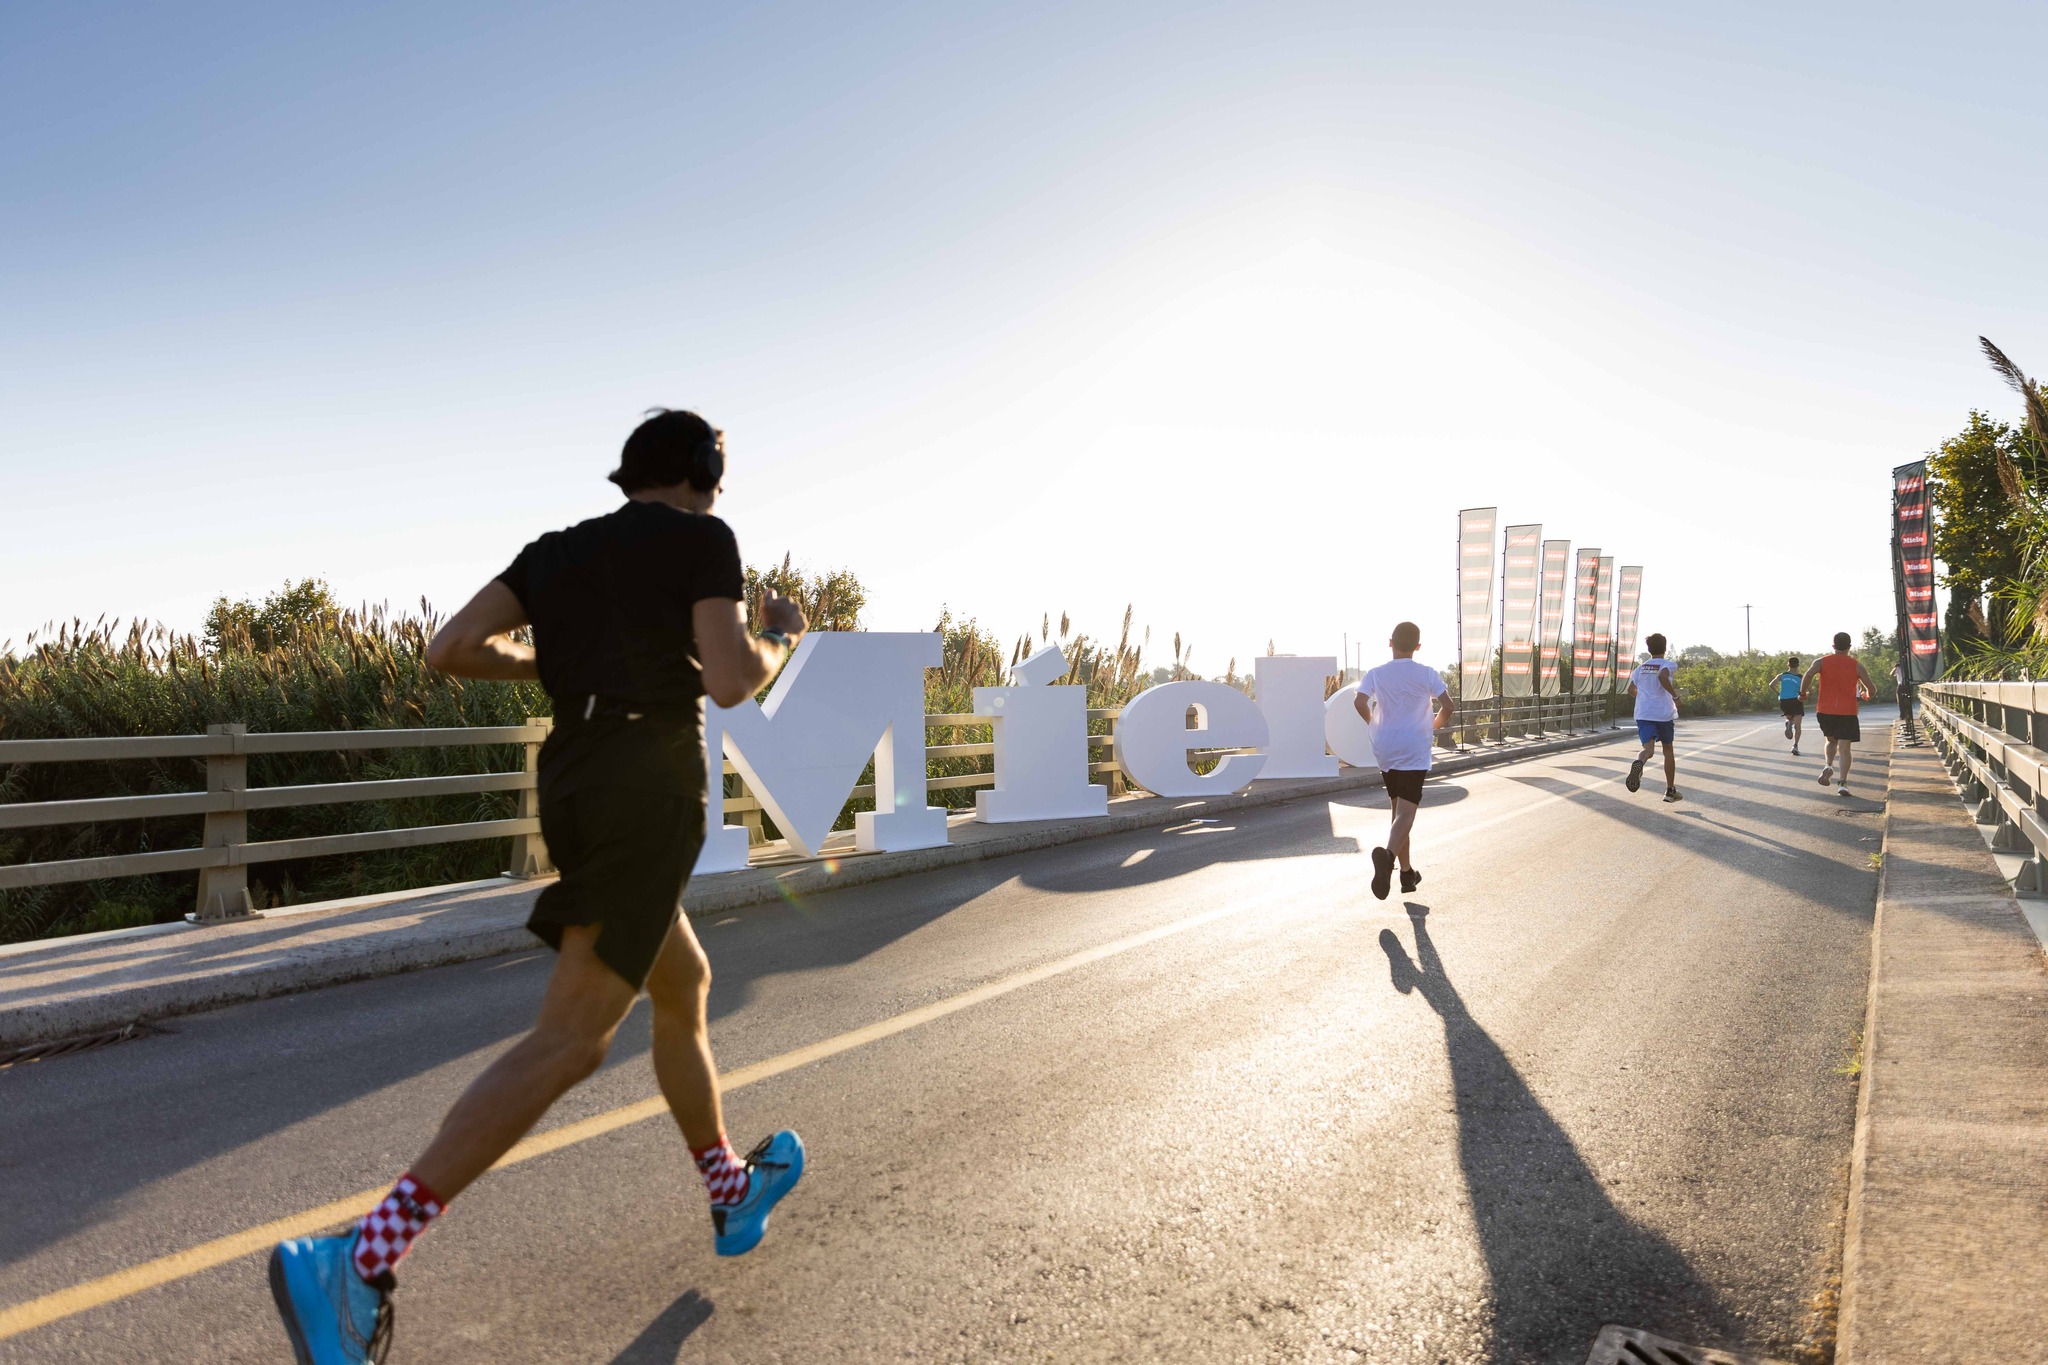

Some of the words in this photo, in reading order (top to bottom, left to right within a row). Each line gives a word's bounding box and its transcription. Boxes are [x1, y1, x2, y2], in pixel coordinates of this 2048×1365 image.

[1903, 536, 1924, 544] Miele
[1907, 563, 1928, 571] Miele
[1915, 643, 1936, 651] Miel
